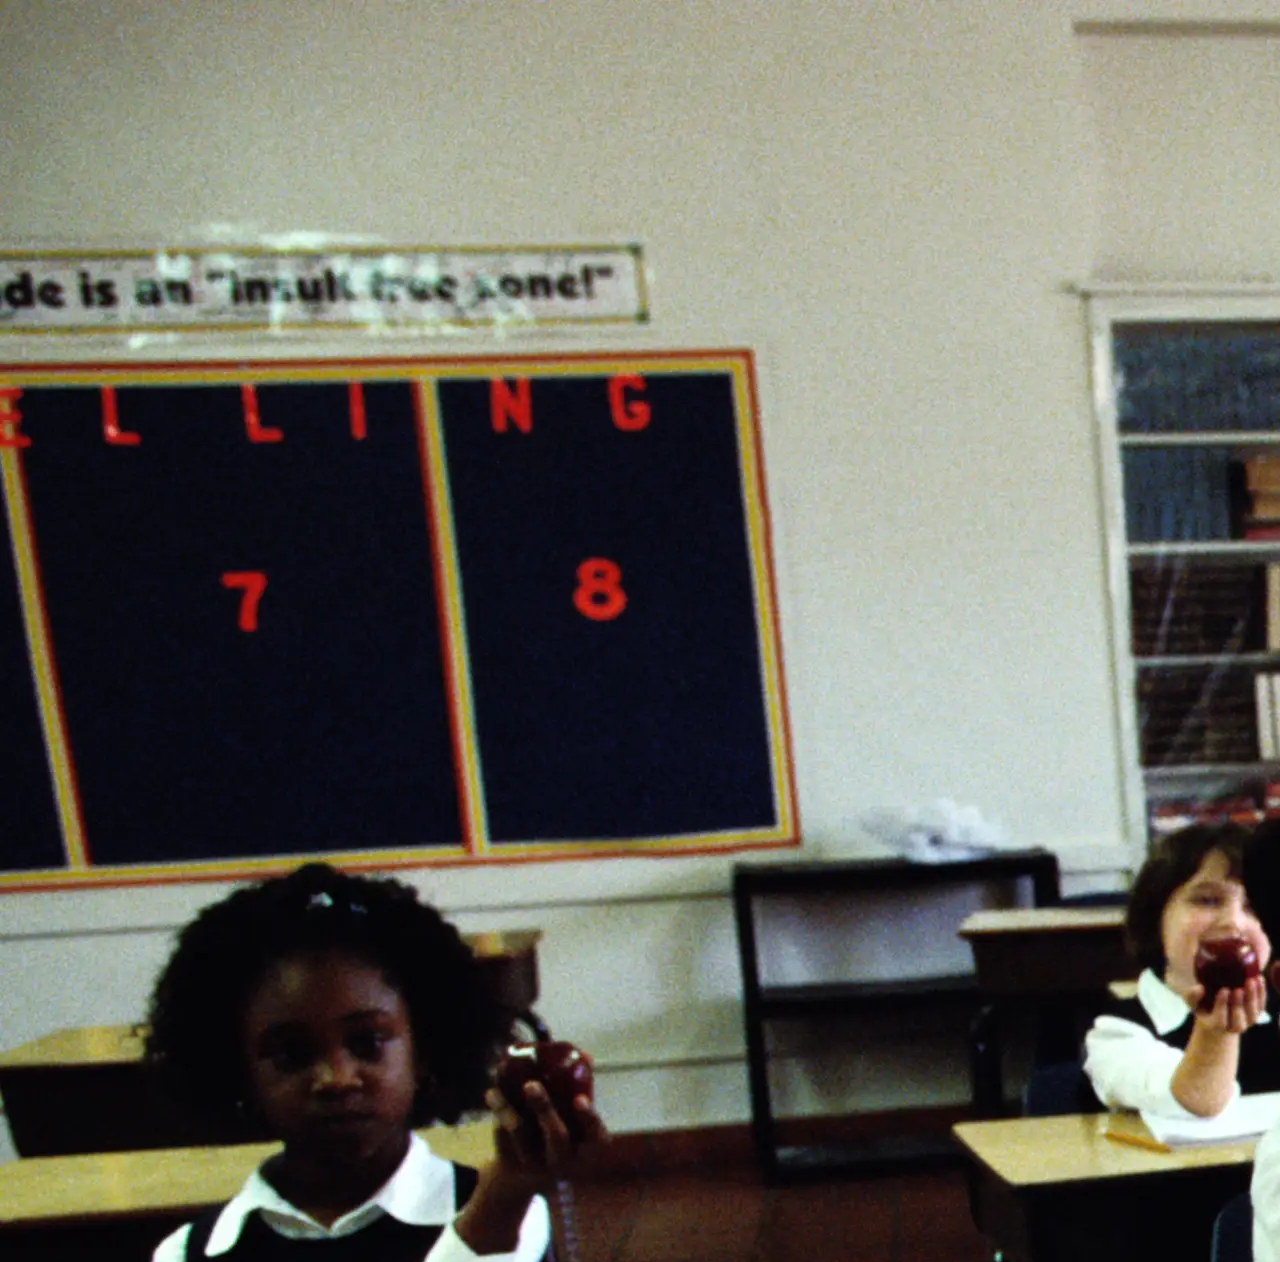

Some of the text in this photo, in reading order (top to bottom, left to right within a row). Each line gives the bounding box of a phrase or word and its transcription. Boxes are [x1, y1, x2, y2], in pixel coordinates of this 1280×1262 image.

[78, 270, 118, 308] is
[135, 278, 193, 308] an
[221, 570, 267, 632] 7
[572, 557, 628, 622] 8
